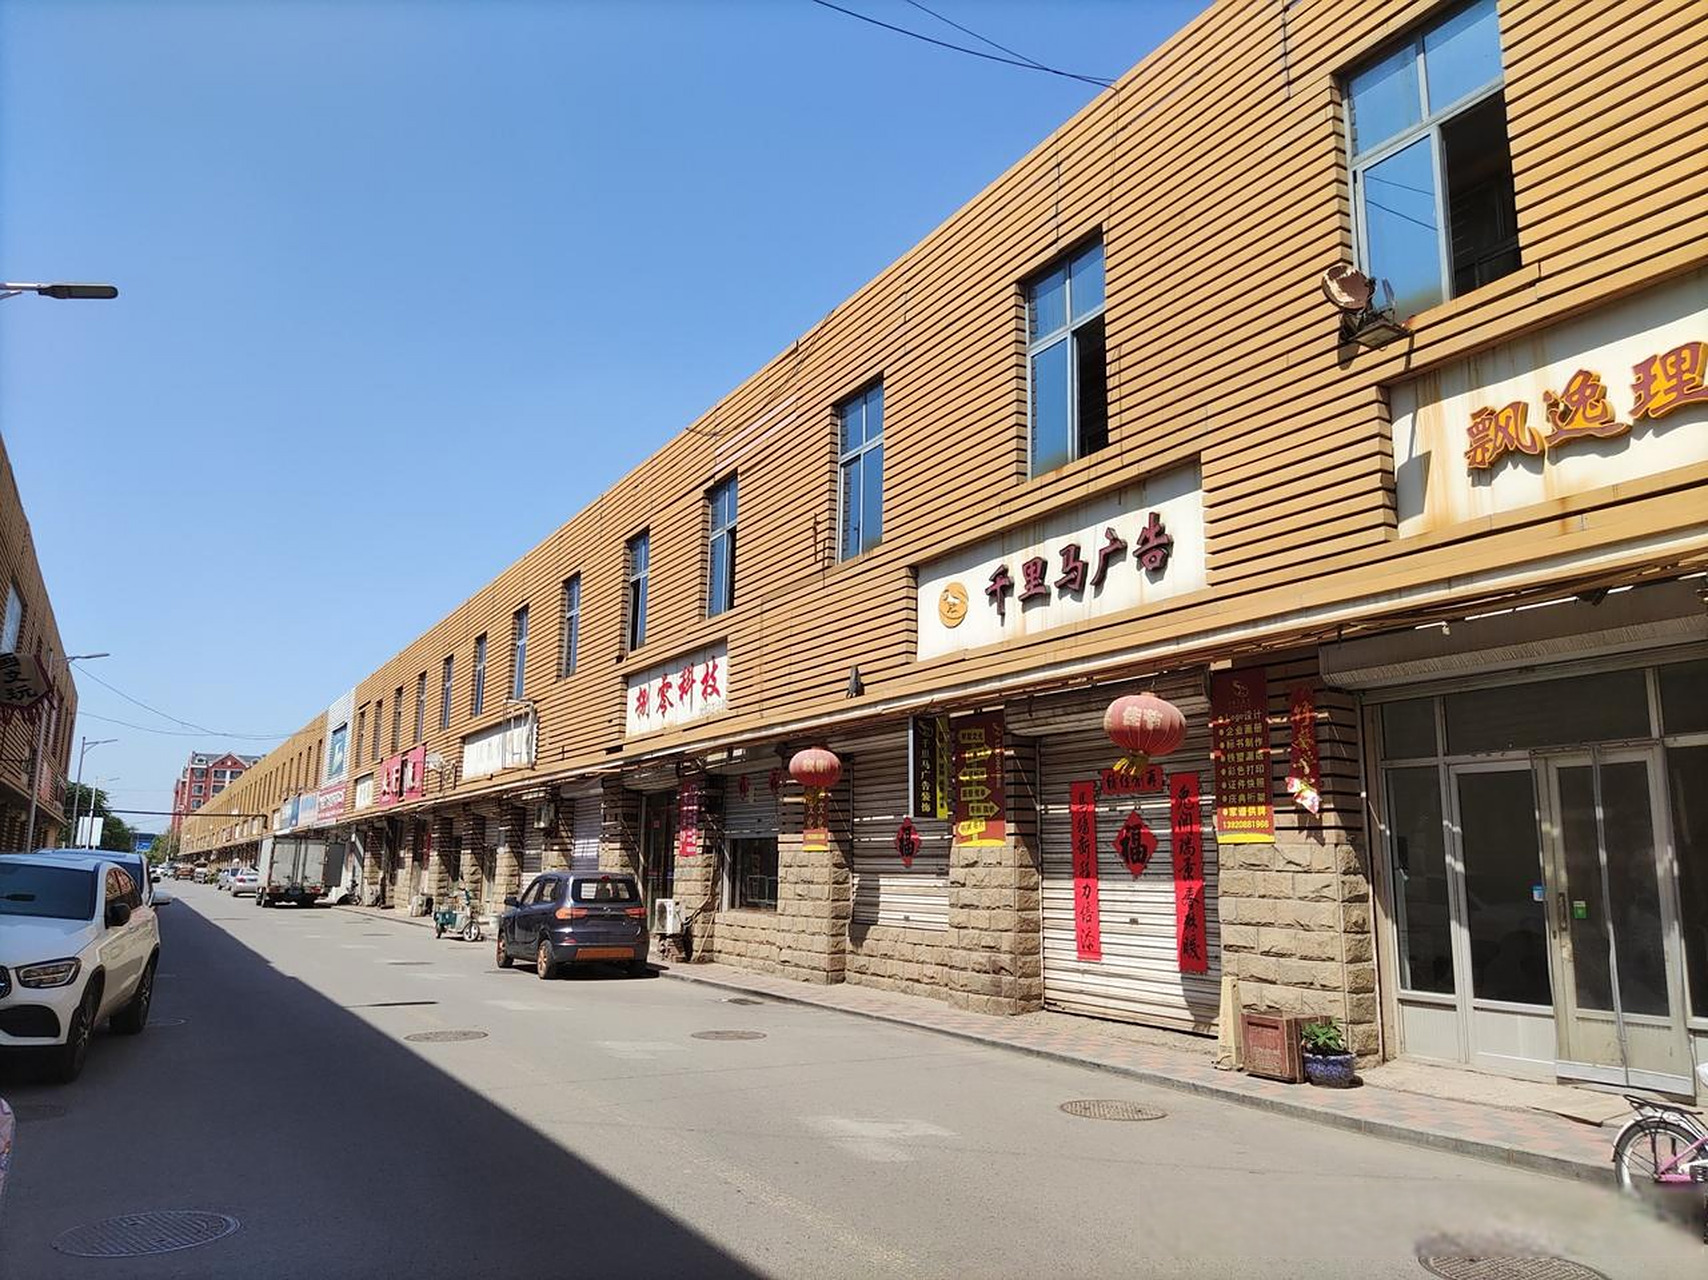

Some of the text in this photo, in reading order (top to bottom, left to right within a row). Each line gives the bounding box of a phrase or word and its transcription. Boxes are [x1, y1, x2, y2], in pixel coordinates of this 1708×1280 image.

[1465, 341, 1708, 470] 飘逸理
[984, 511, 1175, 625] 千里马广告
[635, 655, 721, 720] 捌零科技
[921, 739, 932, 813] 千里马广告装饰
[1227, 763, 1265, 777] 彩色打印
[1228, 776, 1265, 791] 证件快照
[898, 825, 915, 858] 福
[1121, 824, 1148, 865] 福
